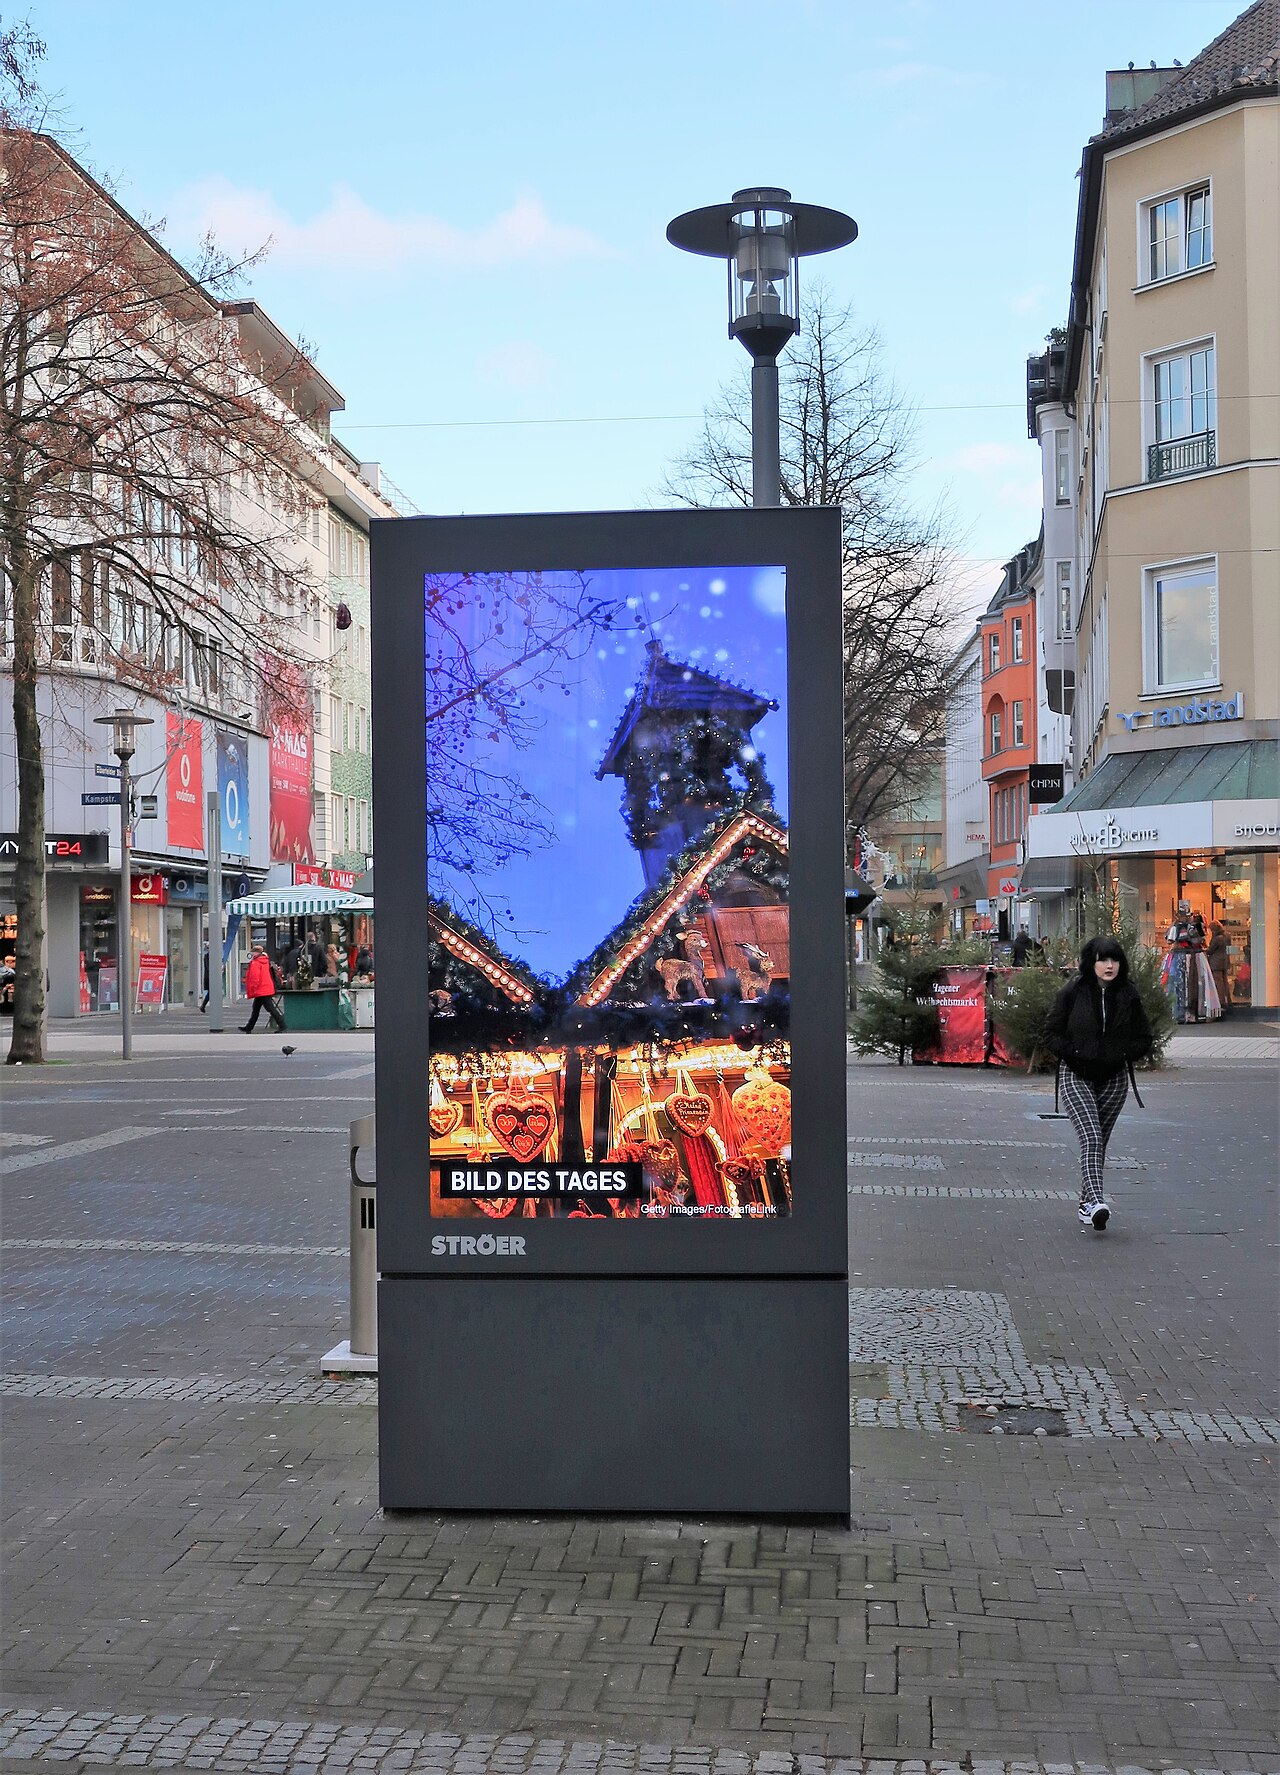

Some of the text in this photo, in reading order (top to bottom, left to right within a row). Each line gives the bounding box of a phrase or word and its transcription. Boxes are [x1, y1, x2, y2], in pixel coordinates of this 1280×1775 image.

[1207, 585, 1217, 646] randstad
[1153, 691, 1245, 728] randstad
[1031, 779, 1062, 789] CHRIST
[84, 795, 117, 803] Kampstr.
[175, 789, 196, 804] vodafone
[451, 1171, 627, 1191] BILD DES TAGES
[640, 1204, 777, 1216] Getty Images/FotografieLink
[431, 1233, 527, 1256] STRÖER
